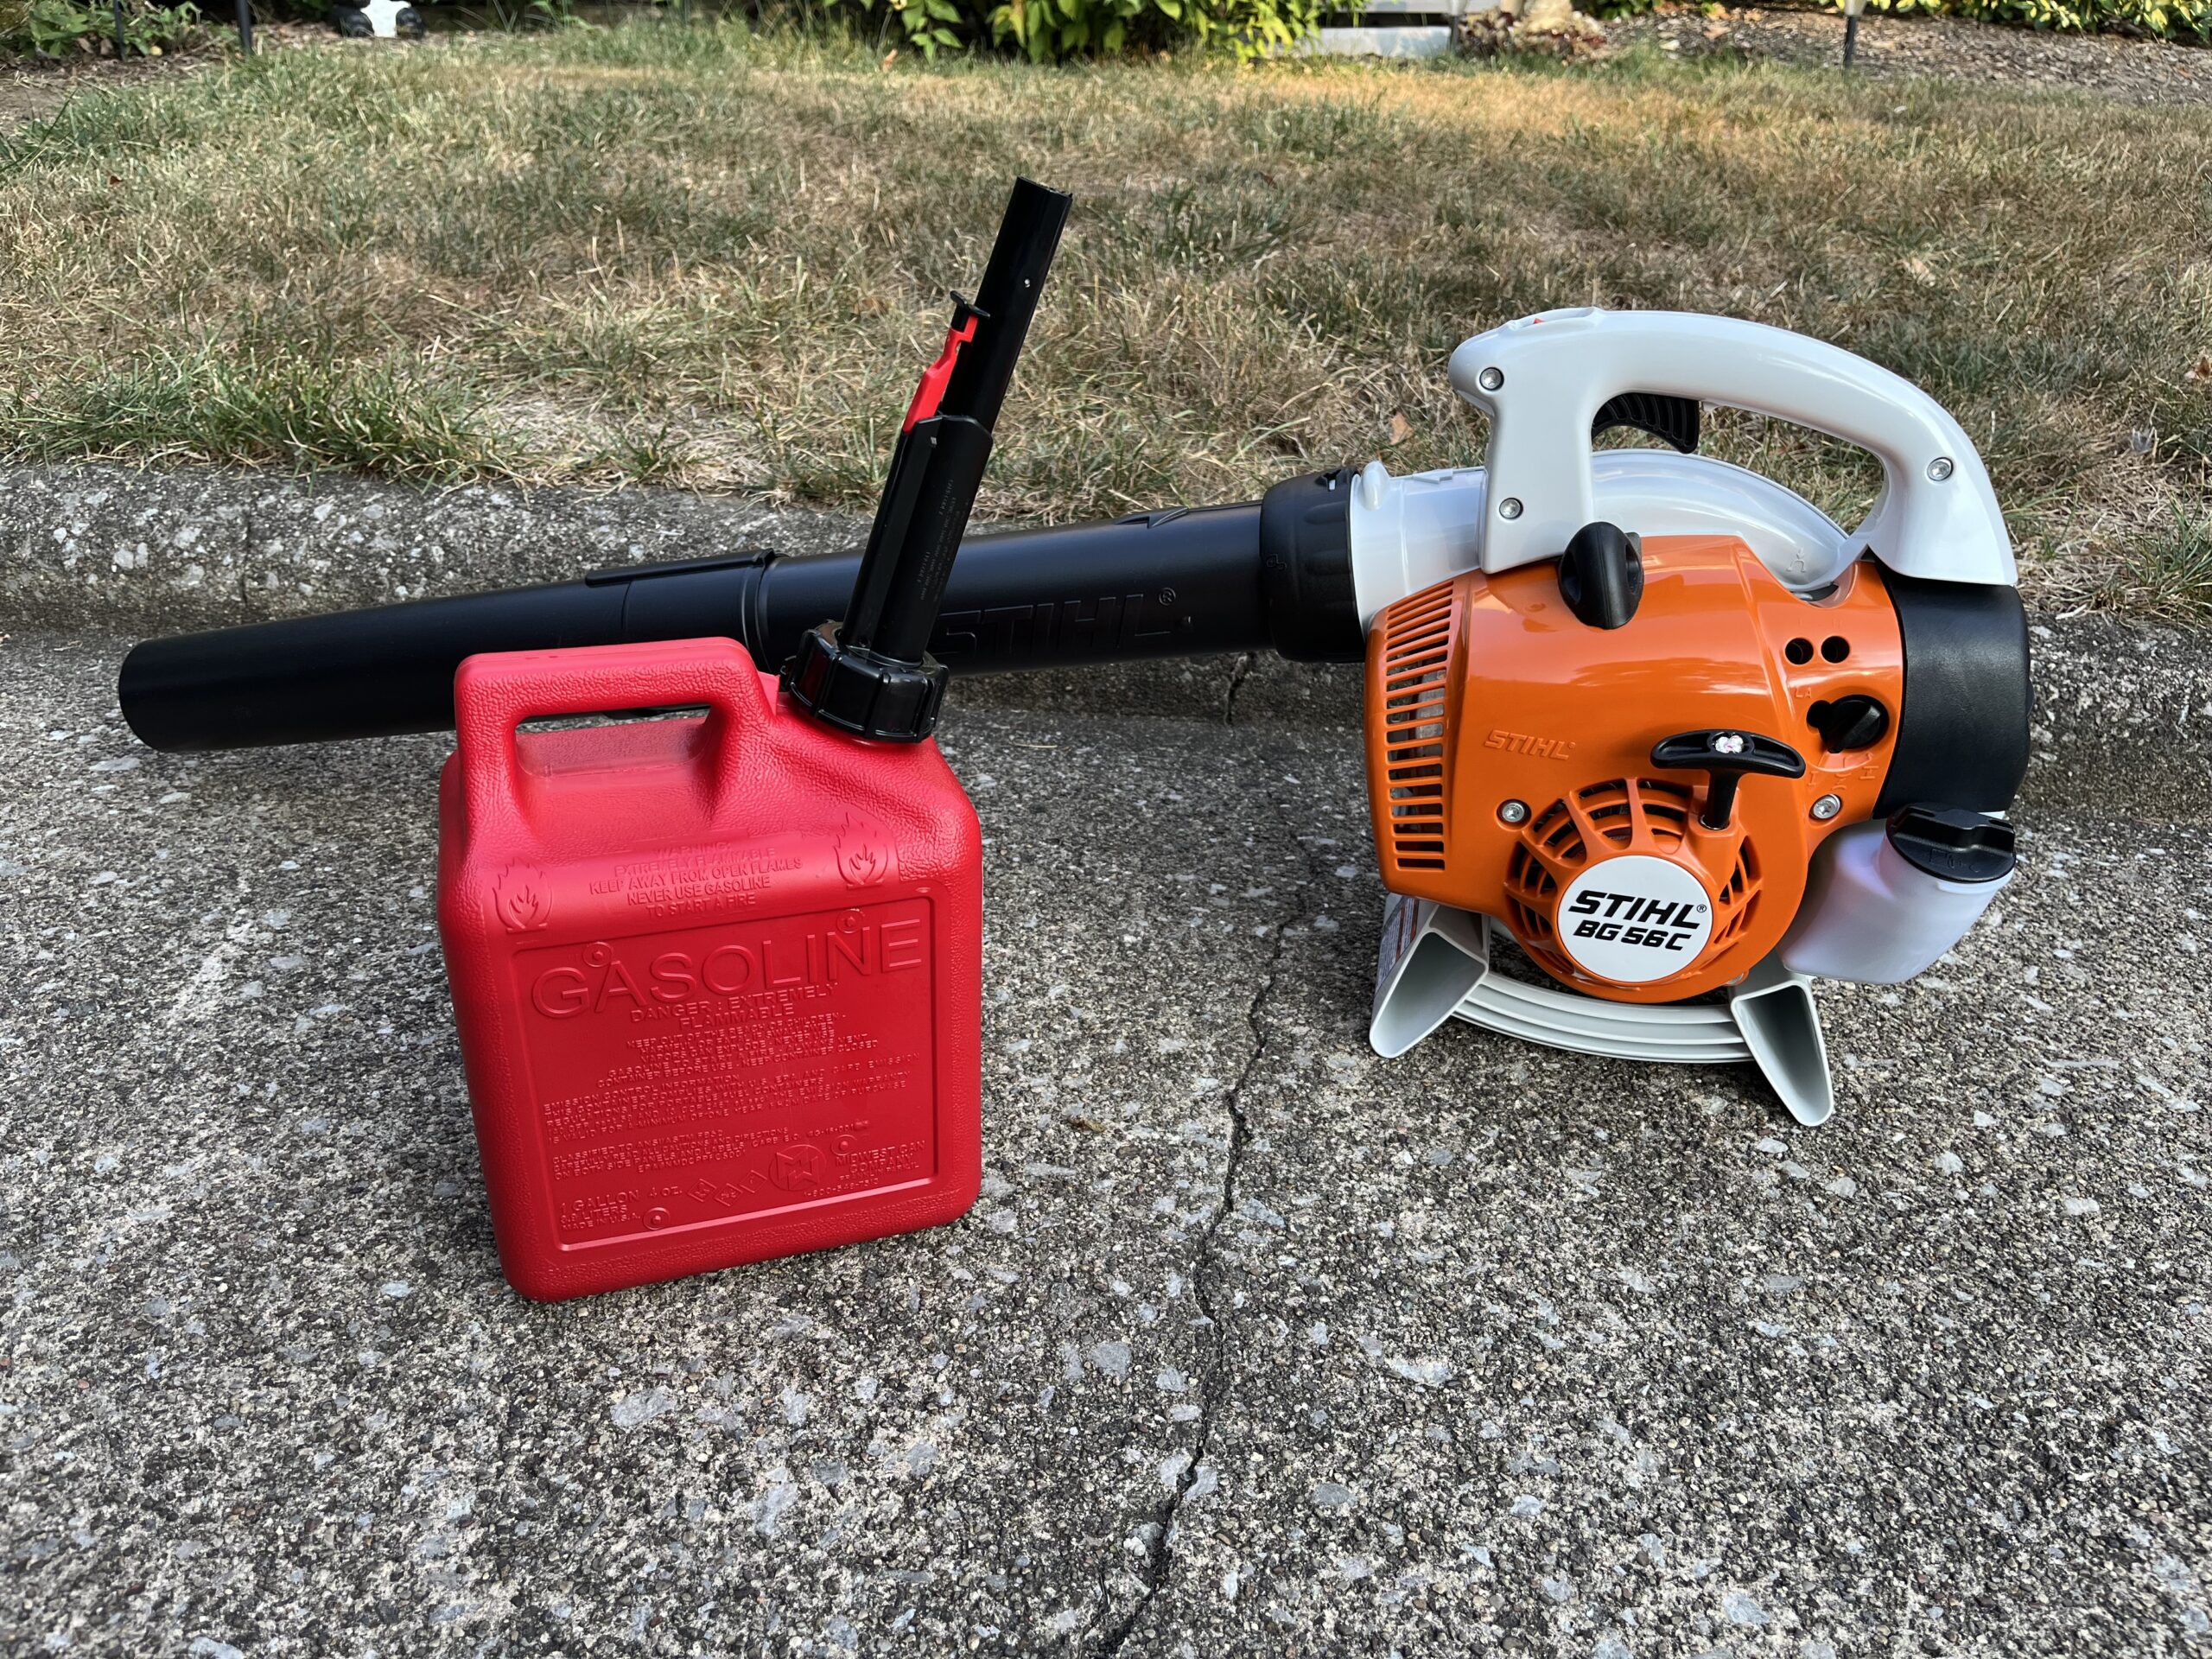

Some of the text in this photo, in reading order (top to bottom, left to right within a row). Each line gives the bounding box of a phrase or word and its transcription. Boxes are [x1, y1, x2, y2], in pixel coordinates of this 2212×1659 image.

[589, 856, 802, 895] KEEP AWAY FROM OPEN FLAMES
[627, 875, 771, 906] NEVER USE GASOLINE
[646, 891, 755, 918] TO START A FIRE
[1568, 889, 1700, 930] STIHL
[531, 918, 922, 1020] GASOLINE
[728, 982, 838, 1008] EXTREMELY
[679, 1002, 793, 1030] FLAMMABLE
[627, 1037, 657, 1049] KEEP
[661, 1033, 683, 1044] OUT
[687, 1031, 700, 1040] OF
[703, 1028, 724, 1039] THE
[728, 1022, 766, 1035] REACH
[769, 1020, 783, 1029] OF
[641, 1040, 693, 1055] HARMFUL
[698, 1038, 712, 1047] OR
[608, 1060, 669, 1077] GASOLINE
[674, 1058, 690, 1068] TO
[641, 1050, 686, 1064] VAPORS
[690, 1046, 712, 1057] CAN
[598, 1070, 660, 1088] CONTAINER
[664, 1063, 709, 1078] BEFORE
[710, 1060, 733, 1071] USE
[835, 1140, 925, 1166] MIDWEST CAN
[849, 1152, 912, 1174] COMPANY
[572, 1189, 639, 1211] GALLON
[649, 1186, 658, 1198] 4
[581, 1204, 627, 1220] LITERS
